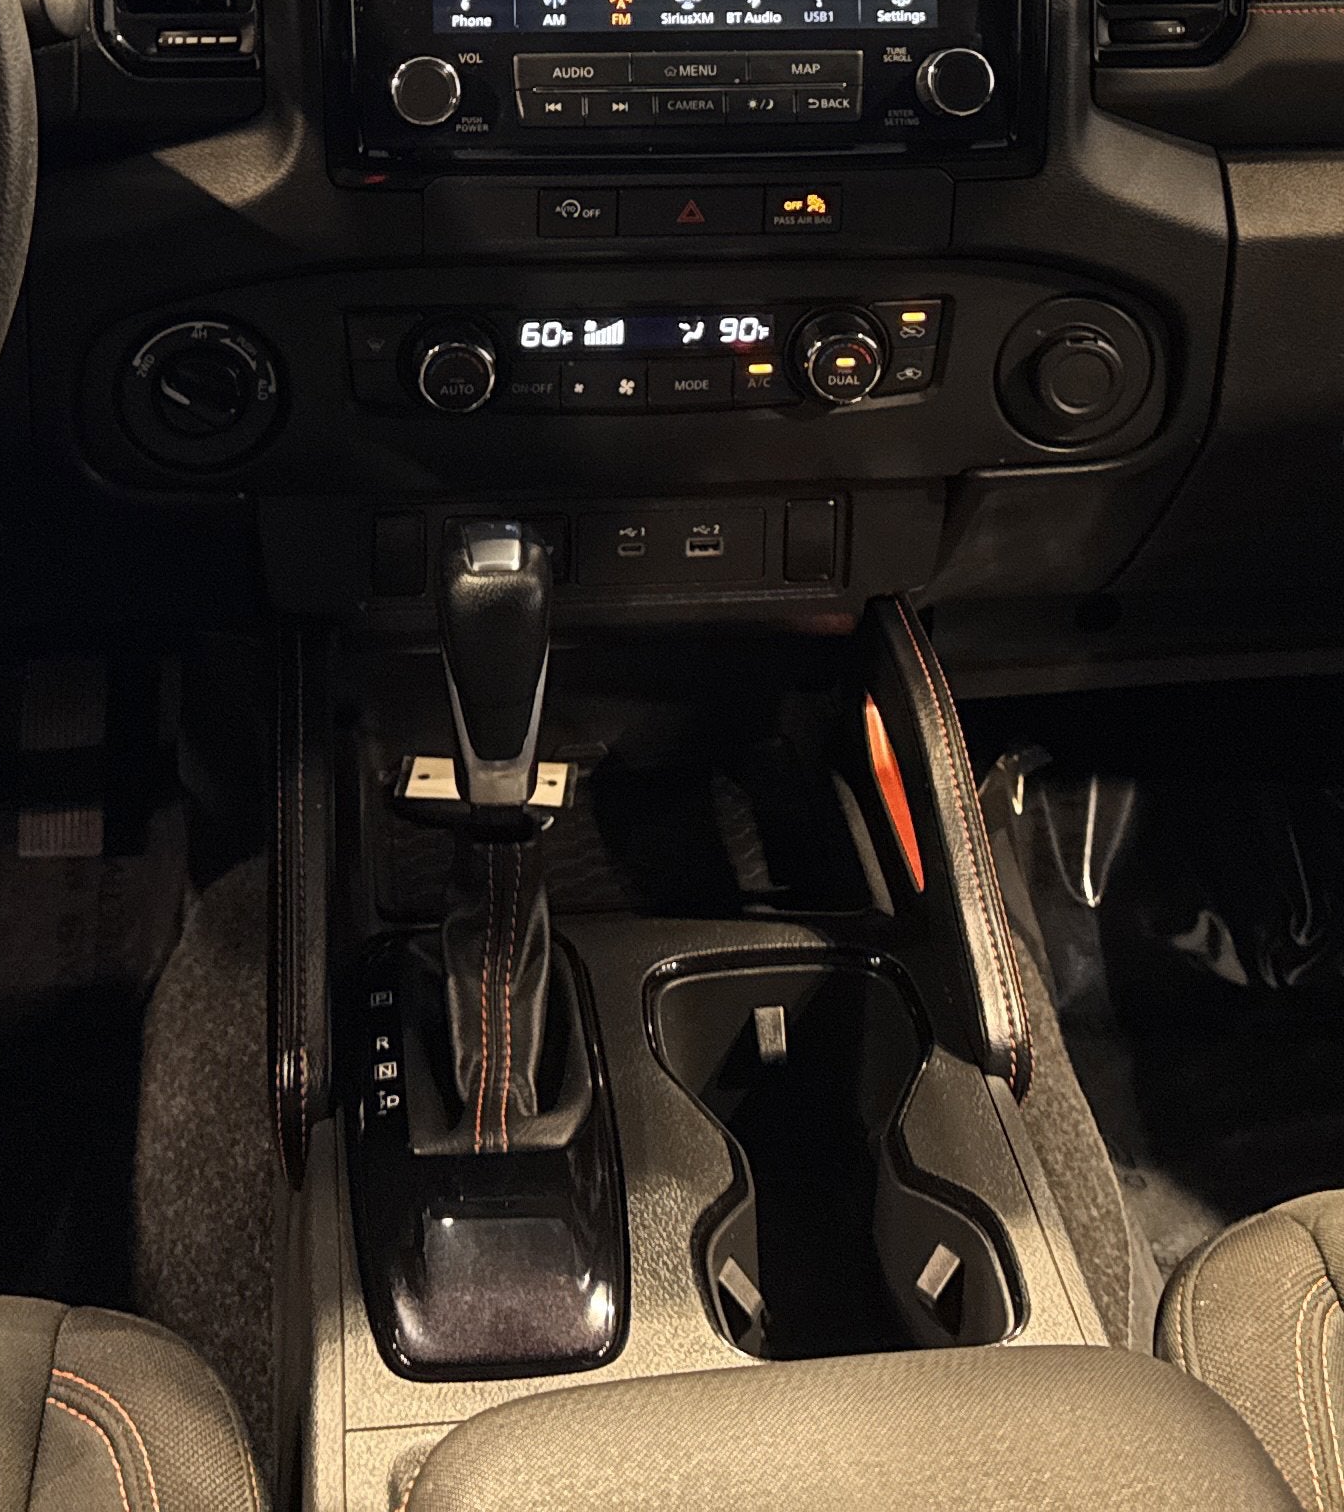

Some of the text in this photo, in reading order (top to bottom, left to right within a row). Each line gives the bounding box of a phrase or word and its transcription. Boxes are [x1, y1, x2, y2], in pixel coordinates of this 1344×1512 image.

[451, 14, 493, 28] Phone
[542, 14, 566, 26] AM
[611, 14, 632, 26] FM
[660, 11, 715, 25] SiriusXM
[726, 11, 782, 24] BT Audio
[804, 11, 834, 23] USB1
[876, 10, 927, 25] Settings
[886, 47, 908, 55] TUNE
[458, 52, 484, 64] VOL
[883, 54, 912, 63] SCROLL
[552, 66, 595, 79] AUDIO
[678, 64, 718, 77] MENU
[791, 63, 821, 75] MAP
[667, 98, 715, 111] CAMERA
[821, 98, 850, 110] BACK
[461, 116, 483, 124] PUSH
[456, 124, 489, 133] POWER
[783, 200, 803, 211] OFF
[582, 208, 601, 218] OFF
[774, 215, 833, 225] PASS AIR BAG
[674, 379, 710, 391] MODE
[747, 376, 771, 388] A/C
[827, 375, 861, 386] DUAL
[440, 383, 474, 396] AUTO
[375, 1036, 390, 1053] R
[386, 1094, 400, 1109] D
